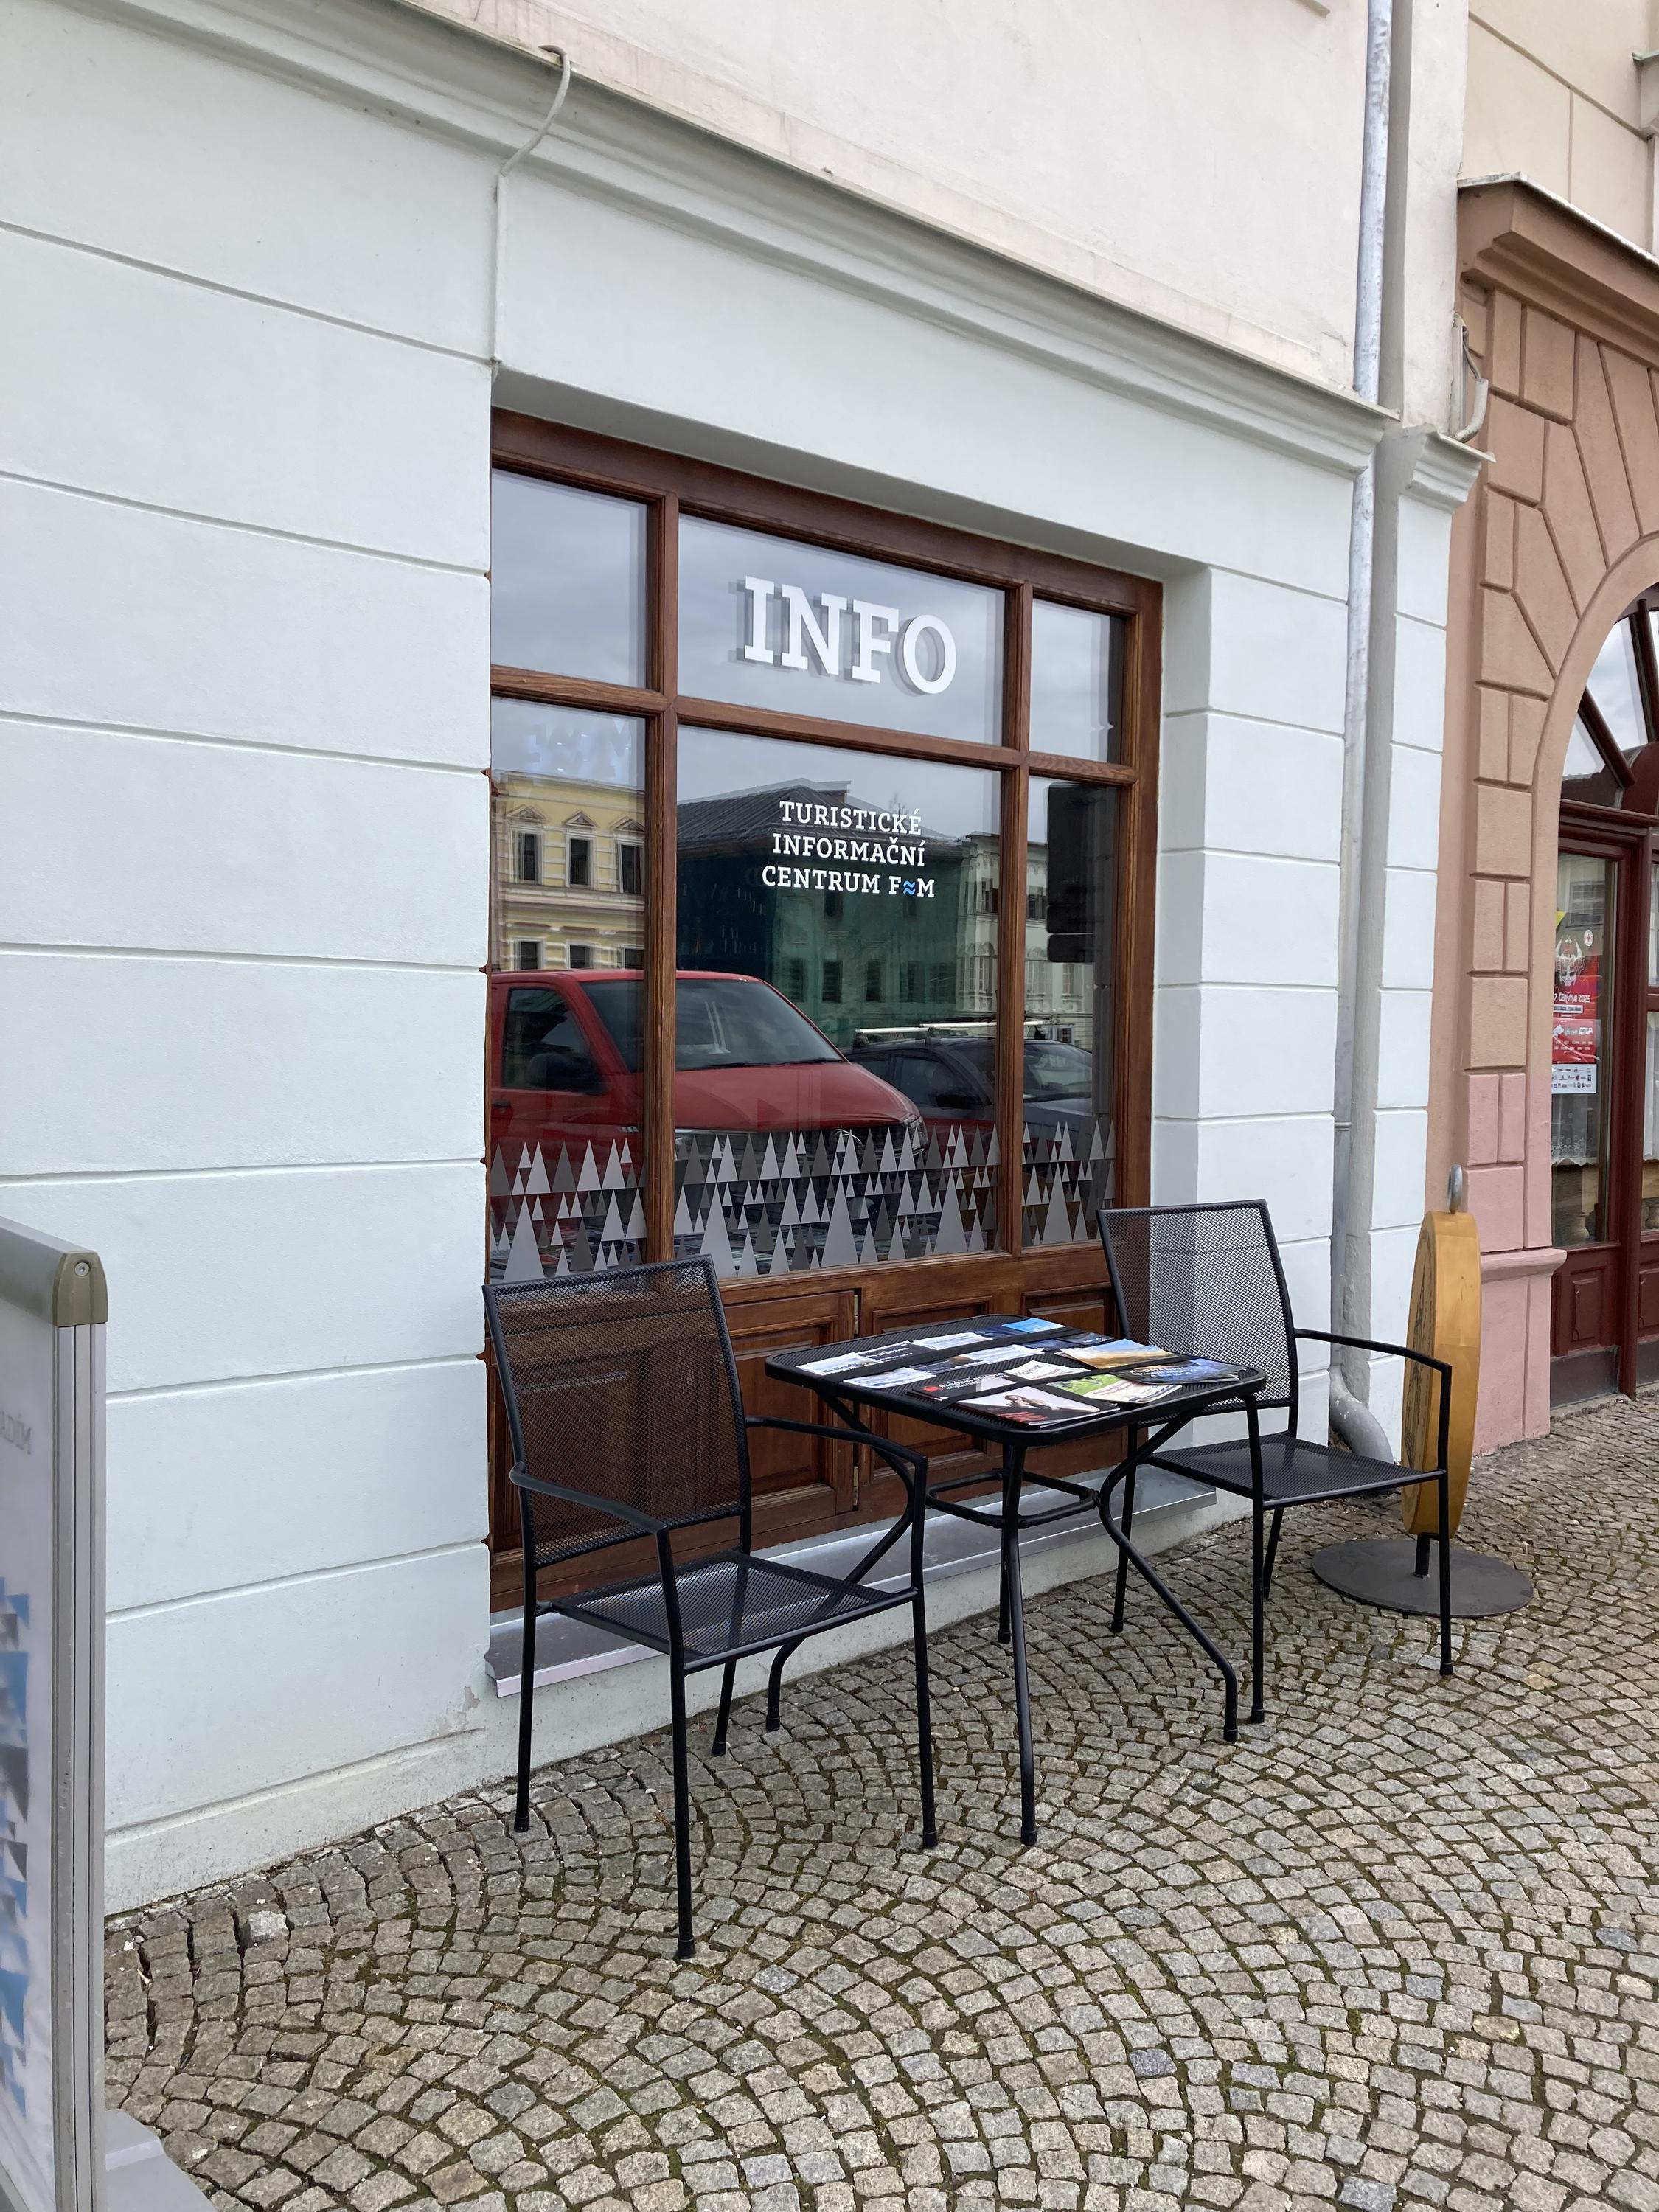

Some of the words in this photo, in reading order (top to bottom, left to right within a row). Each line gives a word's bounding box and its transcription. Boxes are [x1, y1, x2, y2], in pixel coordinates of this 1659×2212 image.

[745, 576, 956, 694] INFO
[779, 800, 922, 835] TURISTICKÉ
[773, 832, 926, 866] INFORMAČNÍ
[762, 865, 880, 894] CENTRUM
